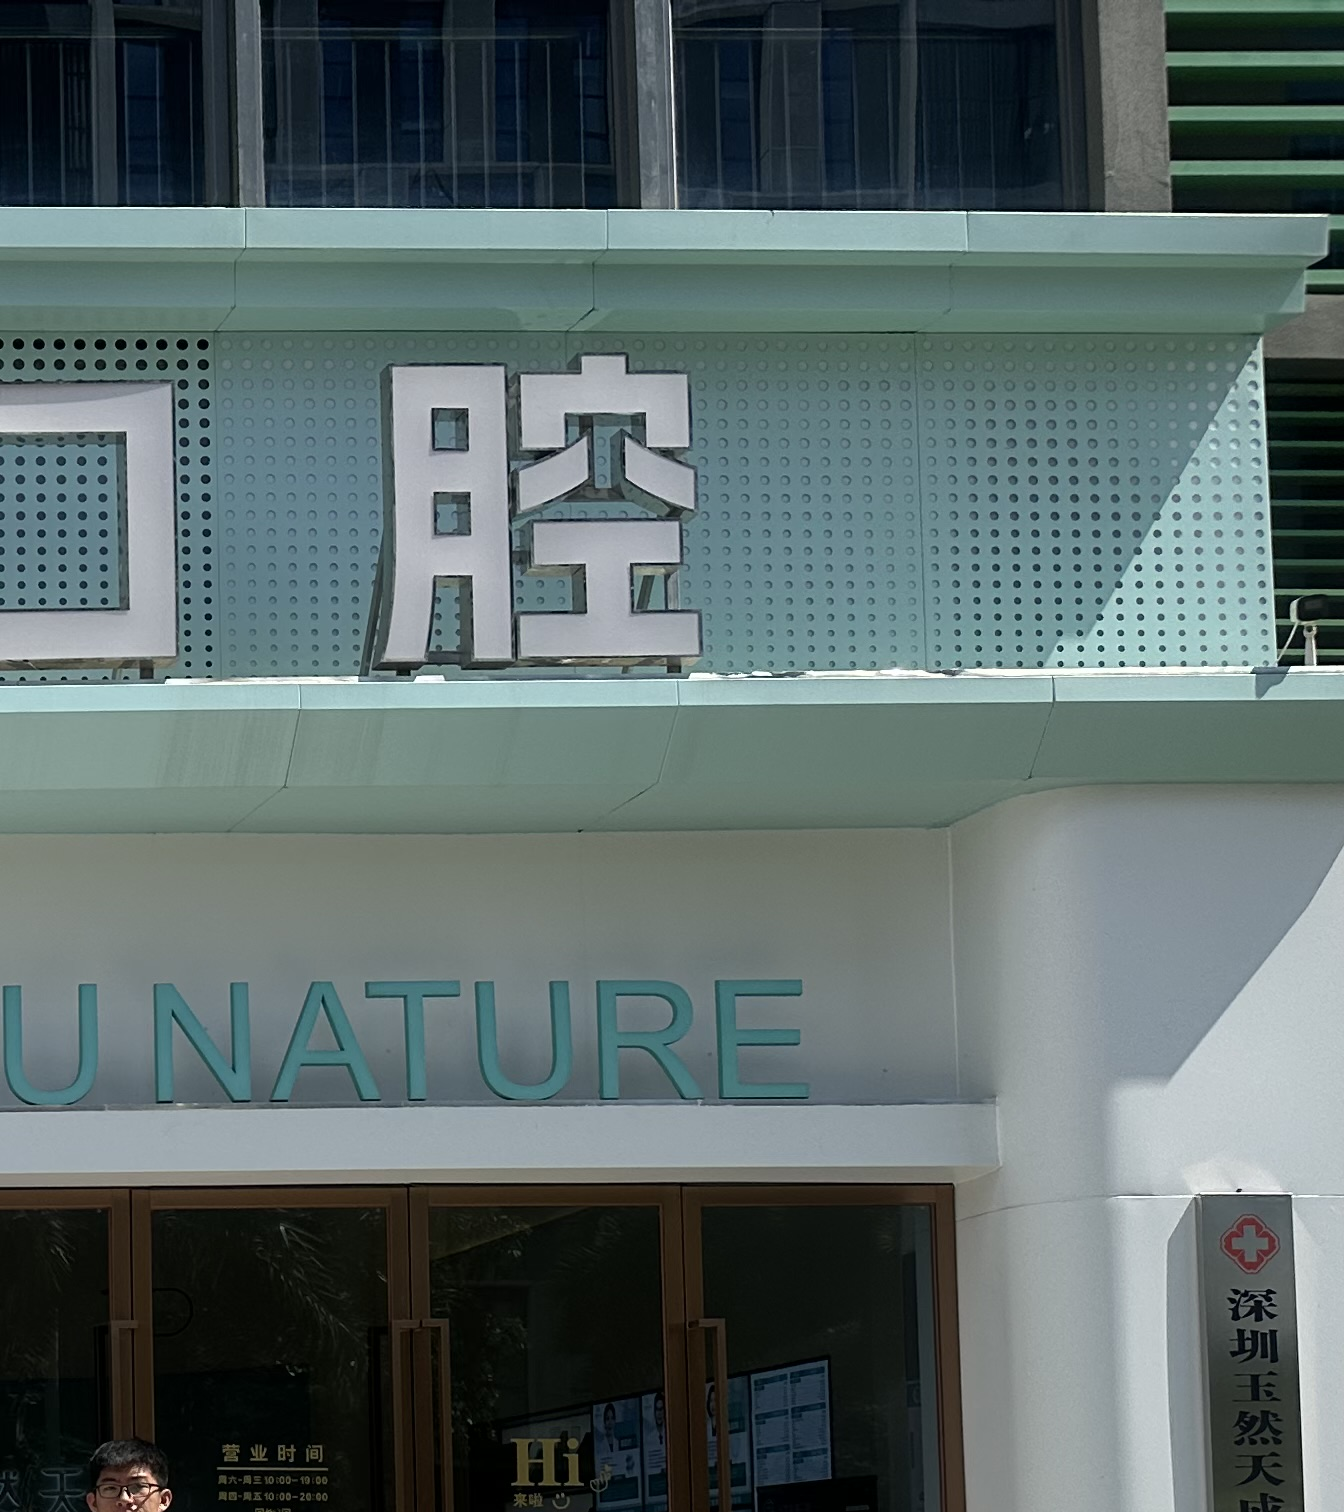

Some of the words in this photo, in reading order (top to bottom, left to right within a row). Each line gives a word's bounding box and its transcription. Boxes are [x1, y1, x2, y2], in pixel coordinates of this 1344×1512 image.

[153, 979, 810, 1103] NATURE
[221, 1444, 324, 1463] 营业时间
[510, 1437, 585, 1487] Hi
[513, 1492, 544, 1508] 来啦
